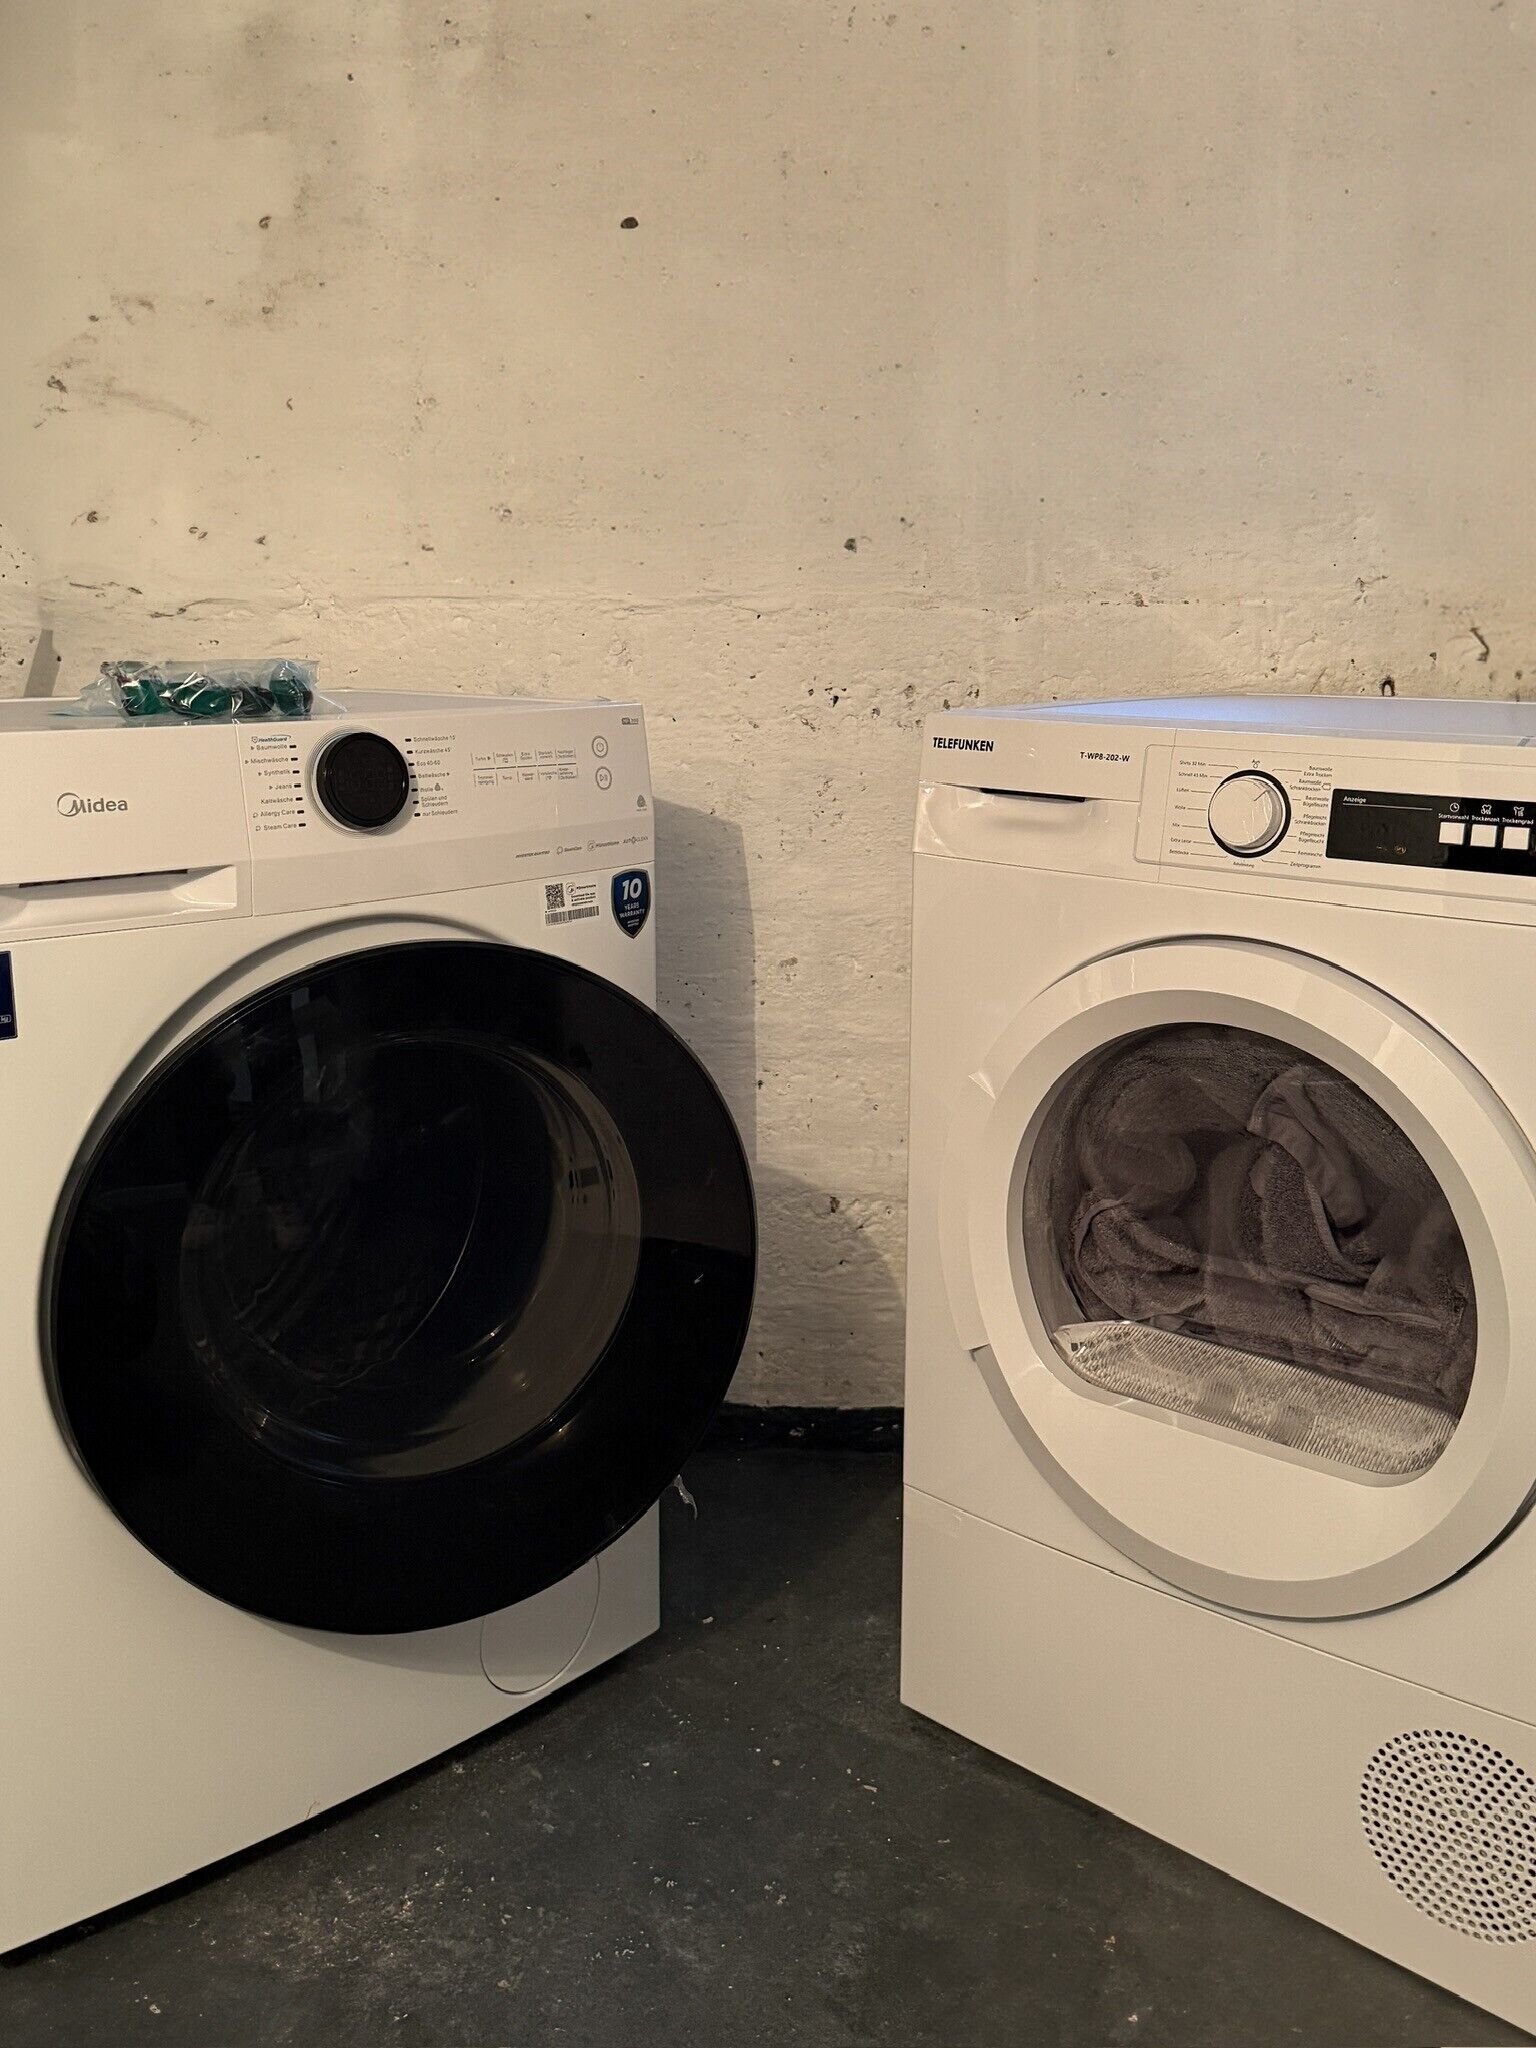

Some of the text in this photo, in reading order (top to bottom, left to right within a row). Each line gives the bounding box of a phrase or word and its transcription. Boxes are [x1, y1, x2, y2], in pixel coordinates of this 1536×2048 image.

[933, 737, 994, 752] TELEFUNKEN
[1343, 795, 1367, 804] Anzeige
[57, 792, 128, 817] Midea
[260, 810, 280, 818] Allergy
[1438, 812, 1470, 821] Startvorwahl
[1471, 814, 1500, 823] Trockenzeit
[1502, 817, 1534, 826] Trockengrad
[622, 878, 642, 900] 10
[624, 902, 640, 910] YEARS
[619, 908, 645, 918] WARRANTY
